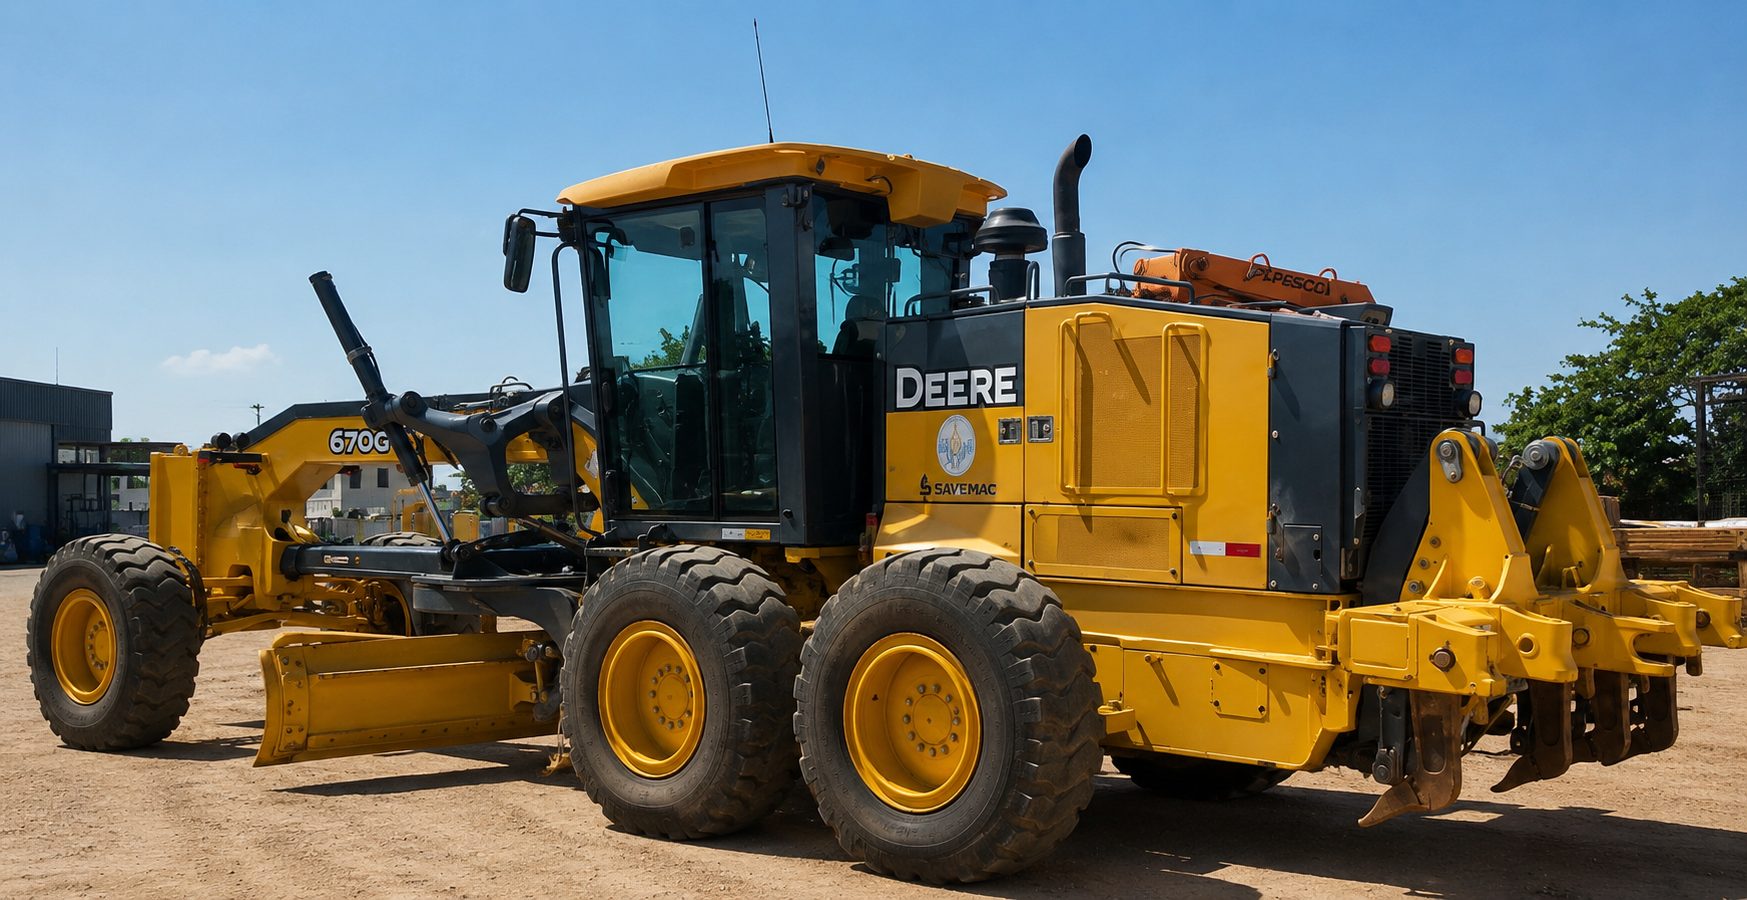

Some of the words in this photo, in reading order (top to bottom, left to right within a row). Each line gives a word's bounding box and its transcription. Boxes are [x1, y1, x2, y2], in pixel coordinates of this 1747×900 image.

[896, 367, 1016, 408] DEERE
[329, 428, 390, 454] 670G
[934, 483, 997, 495] SAVEMAC
